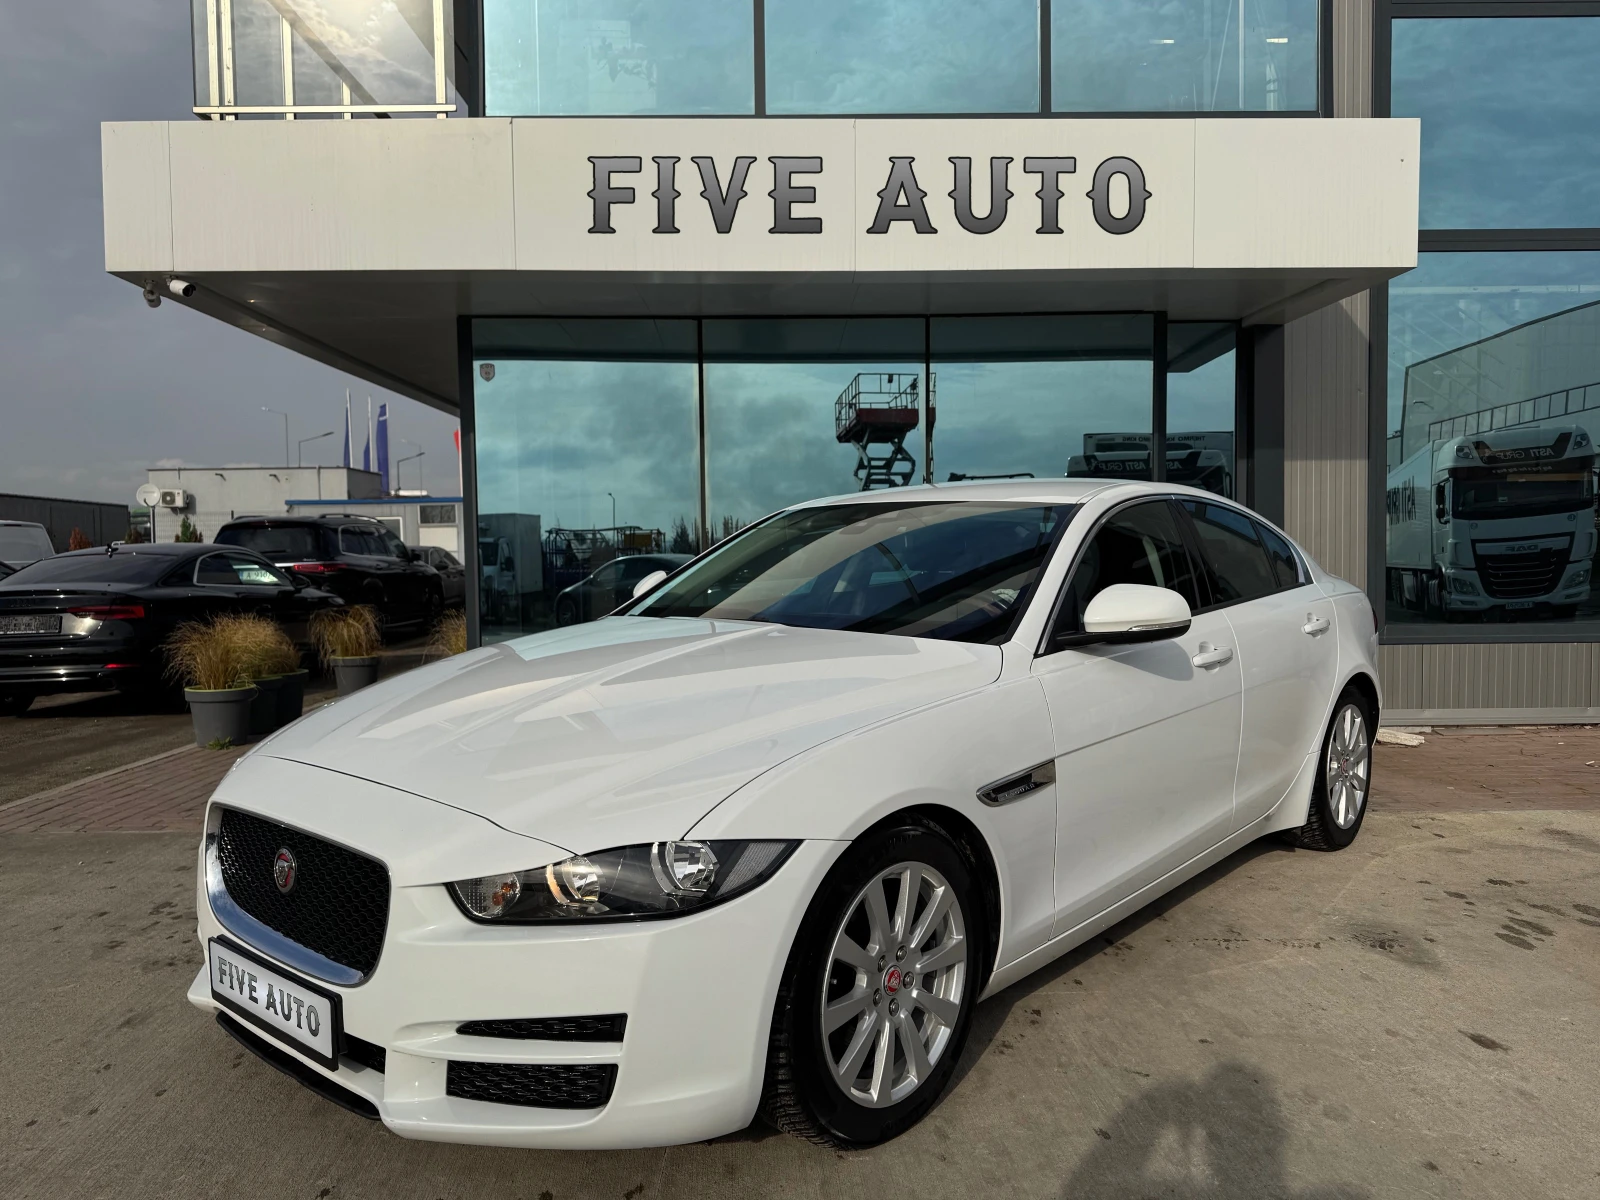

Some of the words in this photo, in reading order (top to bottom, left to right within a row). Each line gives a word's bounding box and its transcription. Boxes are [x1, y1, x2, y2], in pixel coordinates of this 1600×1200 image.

[587, 156, 823, 234] FIVE
[866, 156, 1152, 234] AUTO
[217, 955, 259, 1005] FIVE
[265, 982, 320, 1037] AUTO
